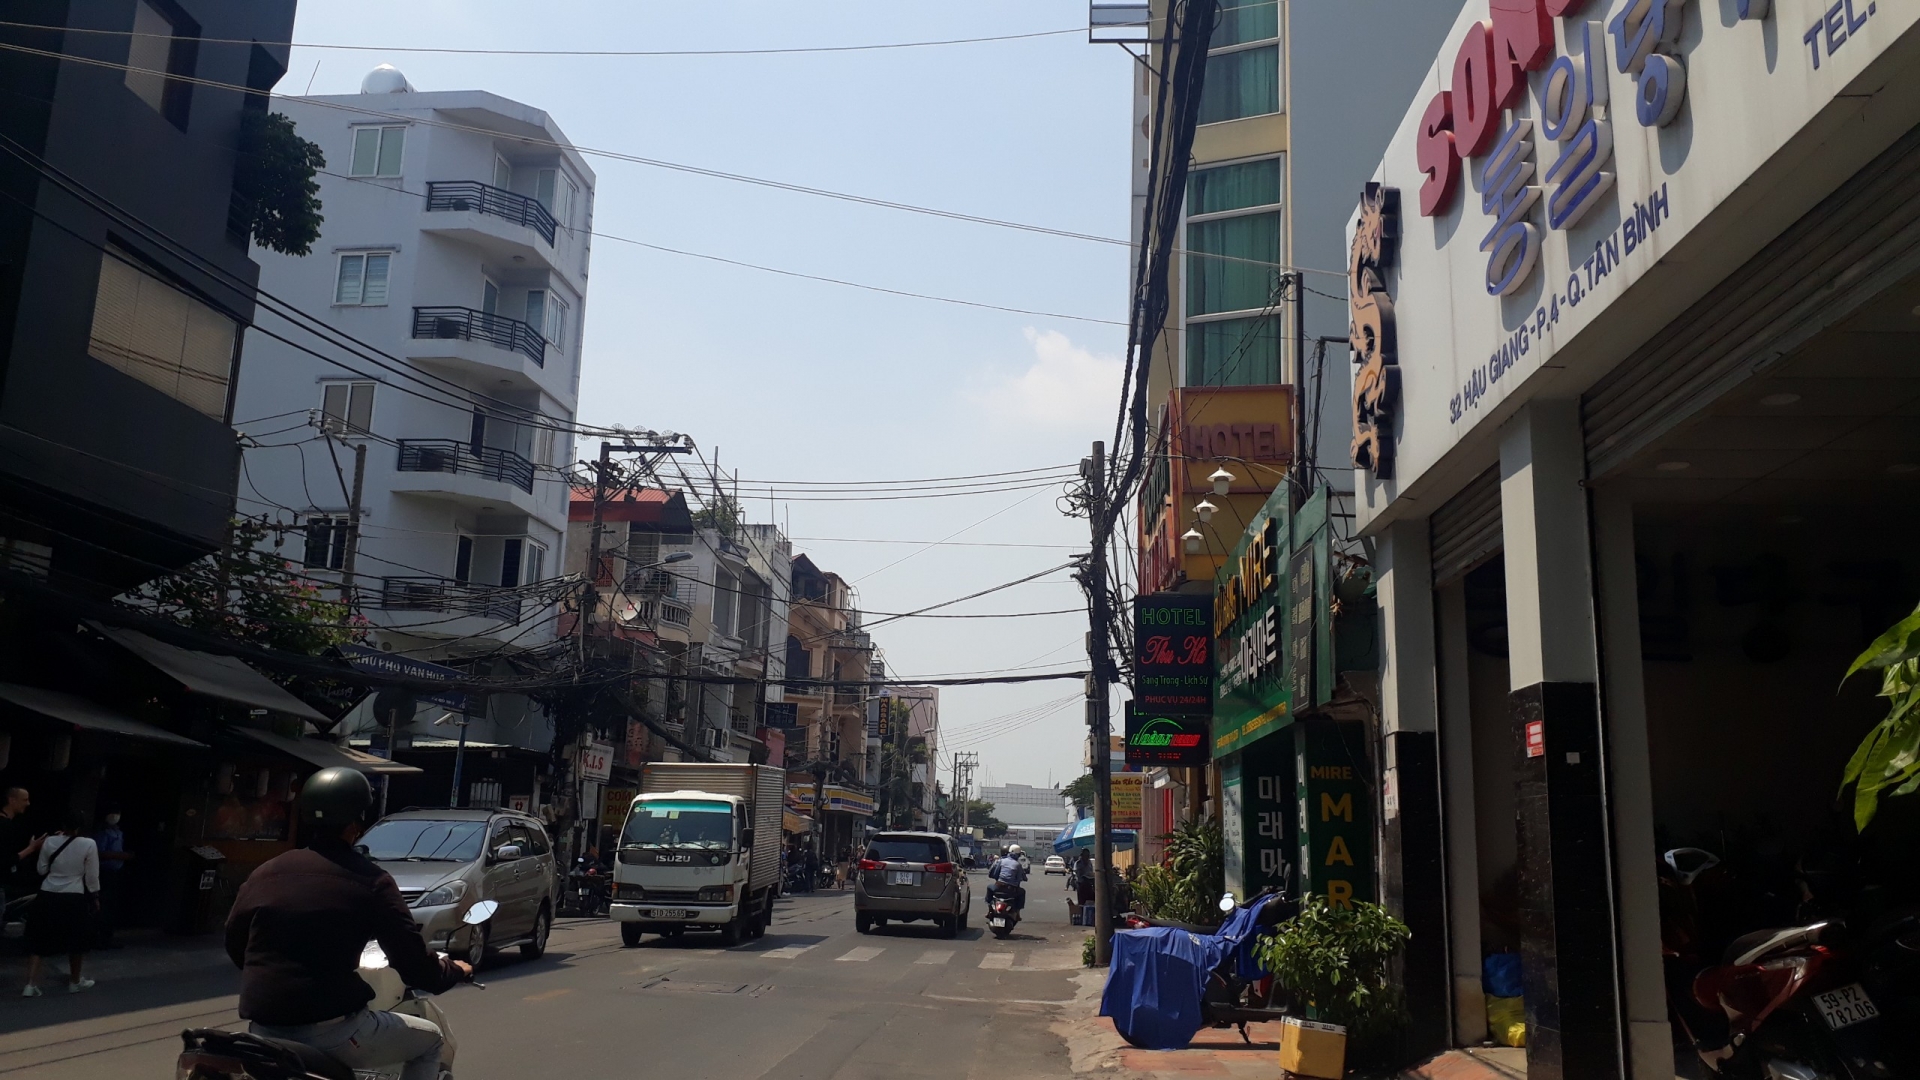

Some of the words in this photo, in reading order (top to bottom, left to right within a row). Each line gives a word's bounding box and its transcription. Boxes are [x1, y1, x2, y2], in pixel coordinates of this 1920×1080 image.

[1417, 0, 1573, 217] SON
[1450, 392, 1462, 425] 32
[1183, 423, 1292, 462] HOTEL
[1141, 607, 1207, 626] HOTEL
[1141, 635, 1175, 665] Thu
[879, 697, 889, 735] MASSAGE
[1310, 765, 1354, 780] MIRE
[655, 854, 691, 863] ISUZU
[1826, 1000, 1875, 1028] 782.06
